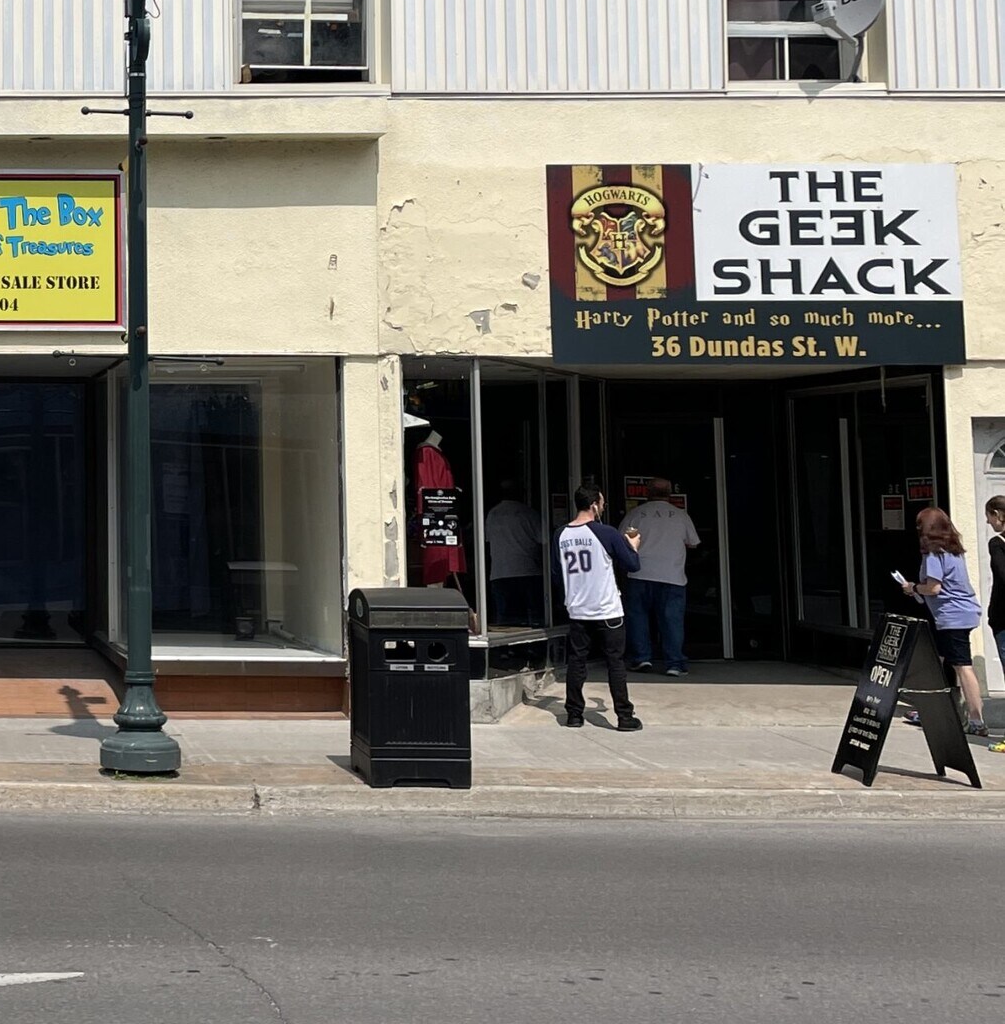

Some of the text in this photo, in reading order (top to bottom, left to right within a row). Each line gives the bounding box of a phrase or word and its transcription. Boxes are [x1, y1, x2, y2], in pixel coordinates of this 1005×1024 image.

[583, 189, 651, 207] HOGWARTS
[769, 170, 884, 203] THE
[57, 193, 104, 227] Box
[738, 209, 922, 246] GEEK
[5, 235, 94, 258] Treasures
[611, 233, 627, 249] H
[1, 275, 42, 290] SALE
[45, 275, 100, 290] STORE
[712, 257, 952, 296] SHACK
[575, 309, 633, 331] Harry
[646, 307, 709, 332] Potter
[722, 308, 756, 327] and
[769, 312, 791, 327] so
[803, 307, 855, 328] much
[651, 336, 868, 358] 36 Dundas St. W.
[575, 538, 592, 547] BALLS
[564, 549, 592, 574] 20
[889, 626, 902, 637] THE
[870, 665, 893, 688] OPEN
